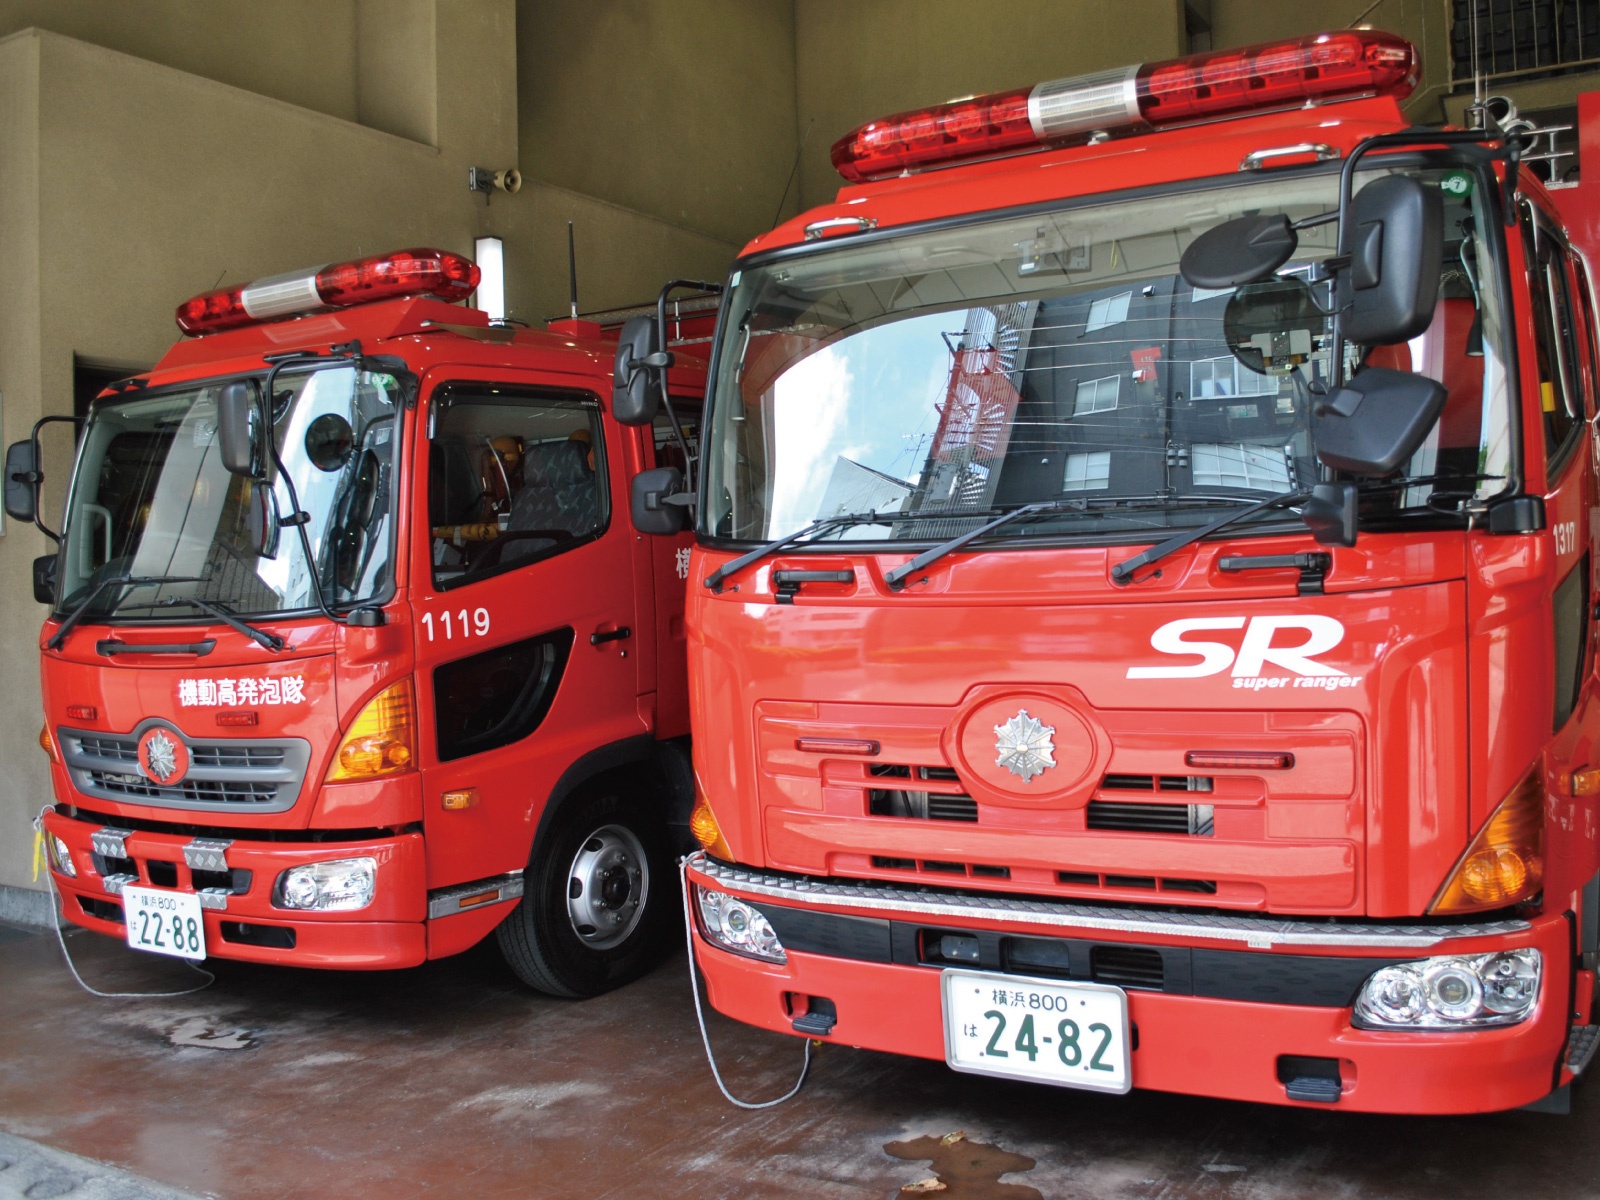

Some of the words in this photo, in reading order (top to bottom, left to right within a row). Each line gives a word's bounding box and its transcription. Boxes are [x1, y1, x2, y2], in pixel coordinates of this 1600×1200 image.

[1553, 522, 1575, 556] 1317
[422, 607, 490, 642] 1119
[1126, 614, 1349, 679] SR
[178, 675, 306, 707] 機動高発泡隊
[1232, 677, 1290, 691] super
[1293, 676, 1363, 690] ranger
[138, 909, 200, 952] 22-88
[964, 1023, 978, 1038] は
[983, 1010, 1115, 1073] 24-82
